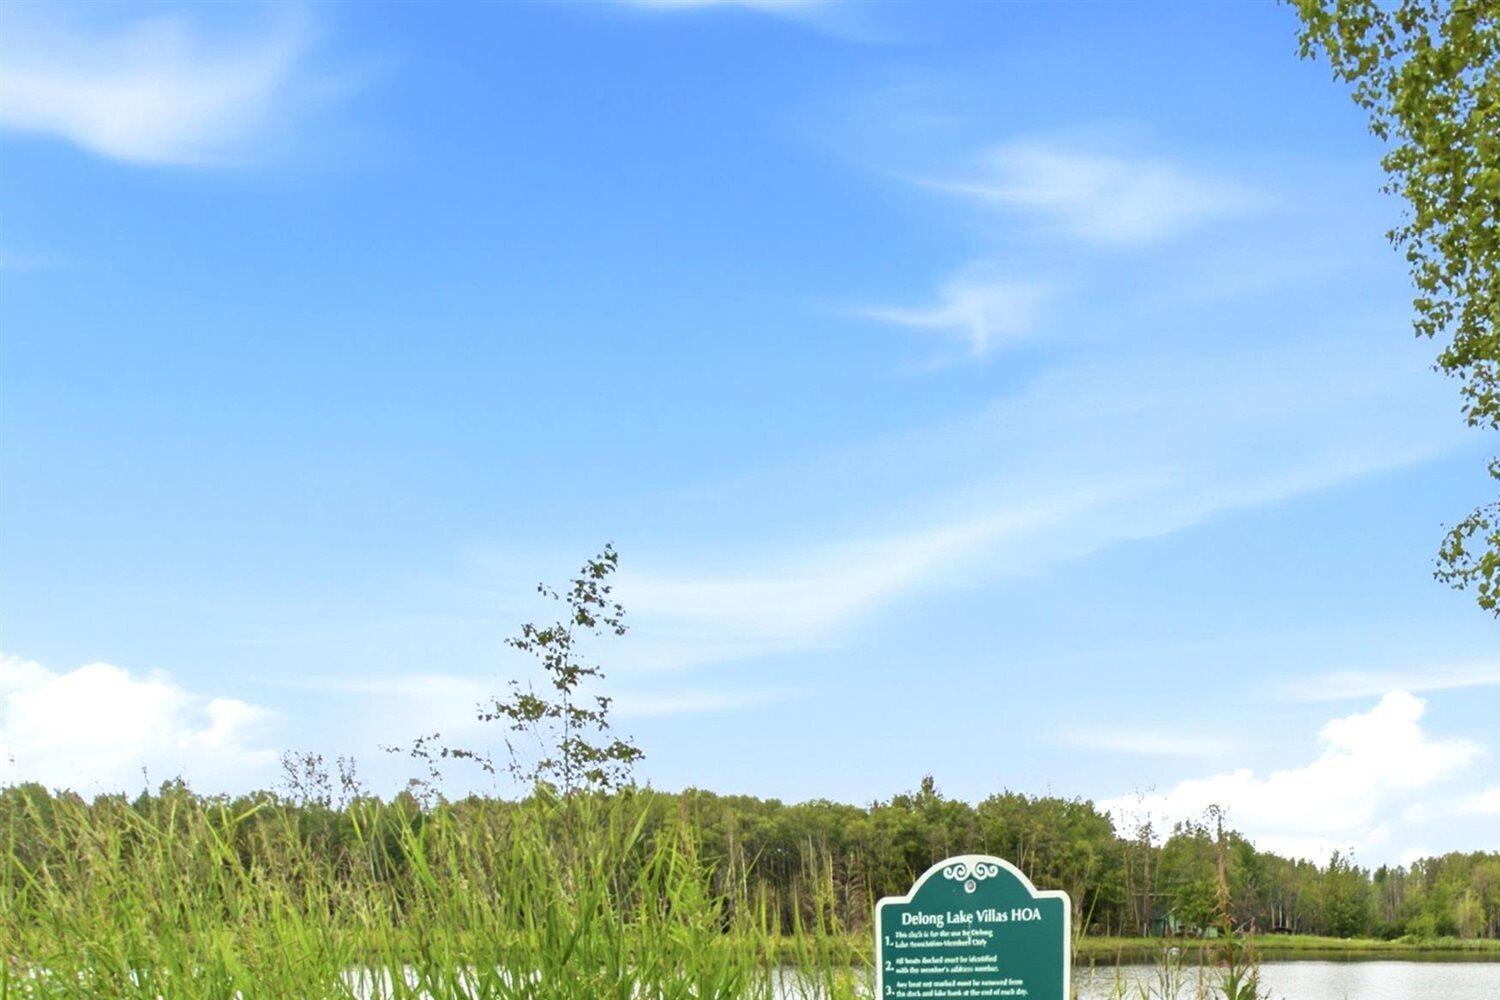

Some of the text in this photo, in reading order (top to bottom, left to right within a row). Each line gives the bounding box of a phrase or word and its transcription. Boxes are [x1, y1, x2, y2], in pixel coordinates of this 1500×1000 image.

[902, 908, 1041, 927] Delong Lake Villas HOA
[885, 936, 894, 946] 1.
[885, 961, 894, 971] 2.
[885, 985, 895, 995] 3.
